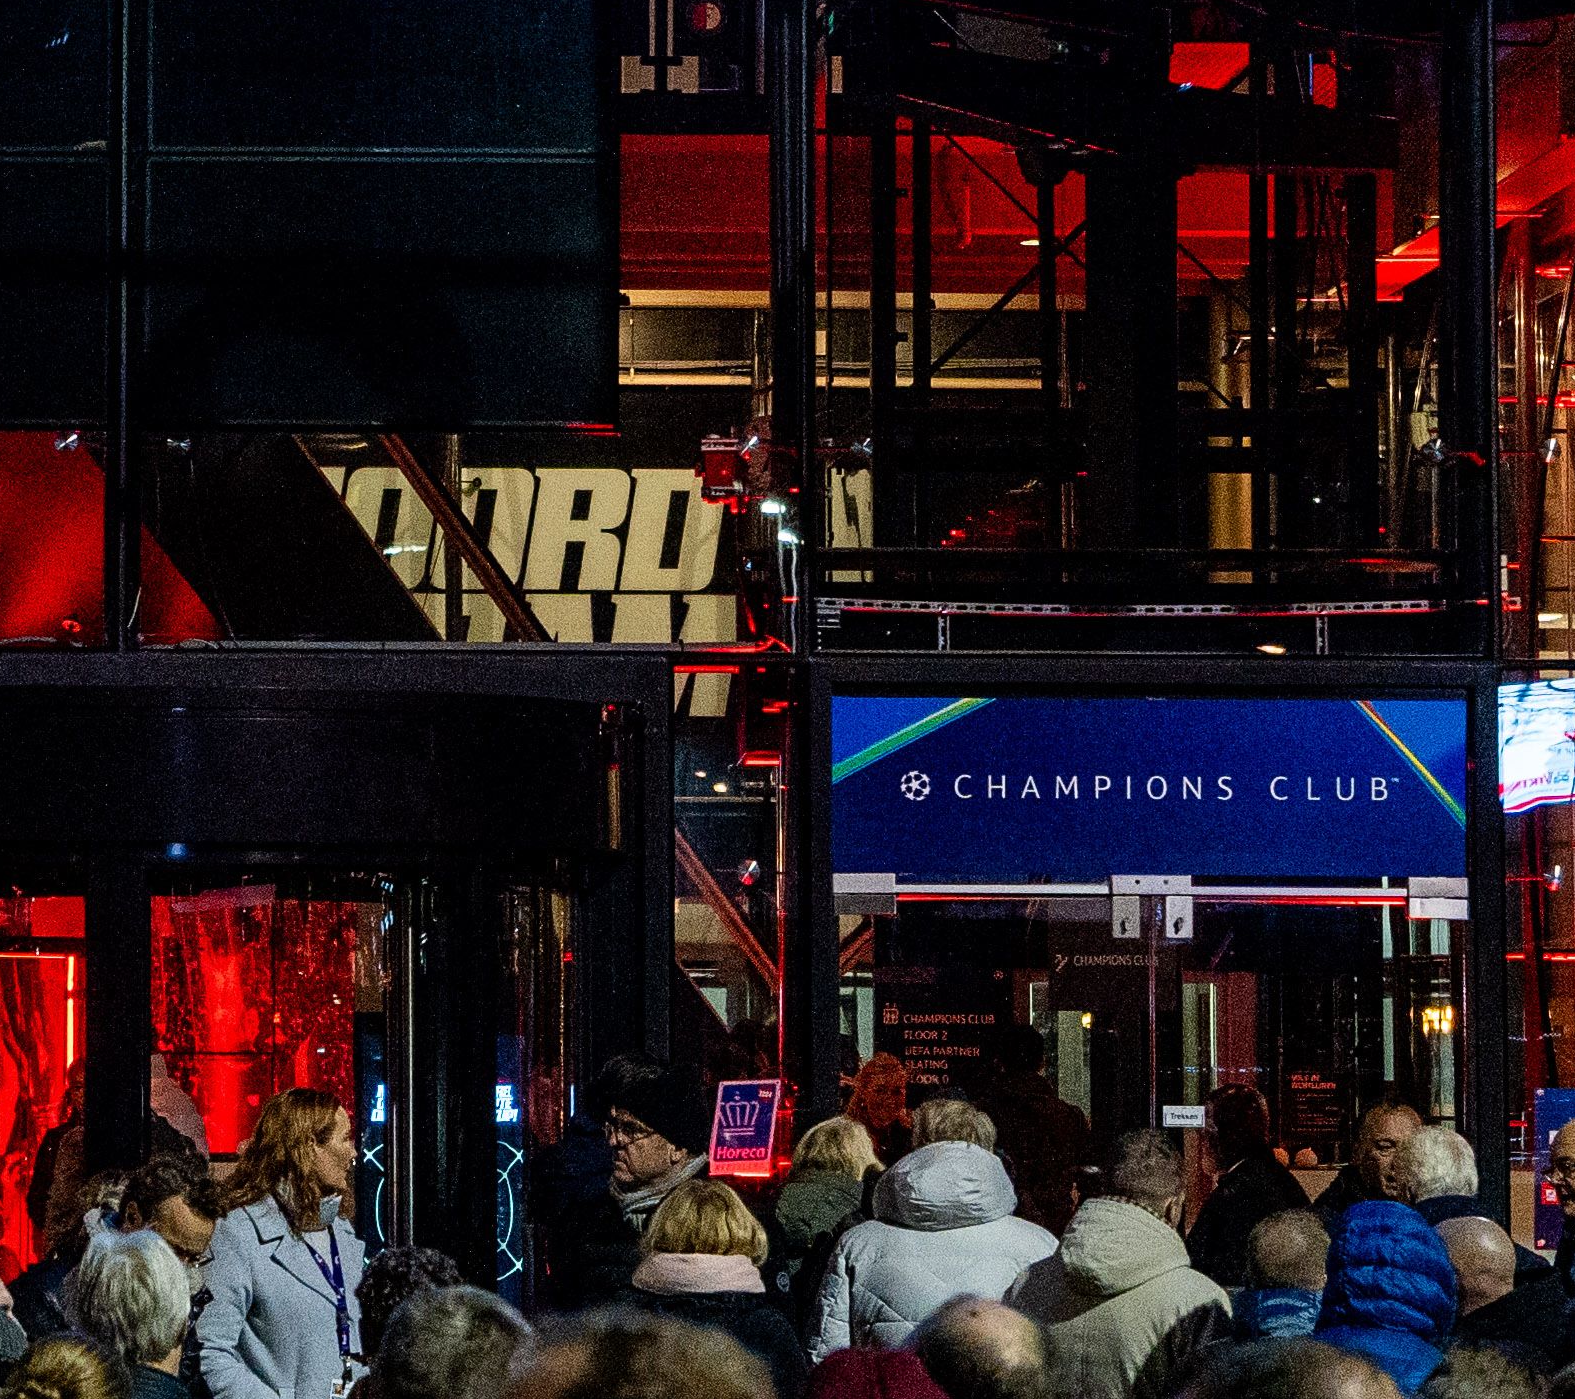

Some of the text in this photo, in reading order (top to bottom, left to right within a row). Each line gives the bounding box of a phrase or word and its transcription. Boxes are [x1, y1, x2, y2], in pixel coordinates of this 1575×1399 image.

[318, 466, 718, 591] OORD
[953, 773, 1234, 801] CHAMPIONS
[903, 1013, 995, 1025] CHAMPIONS CLUB
[904, 1029, 938, 1040] FLOOR
[716, 1146, 766, 1160] Horeca
